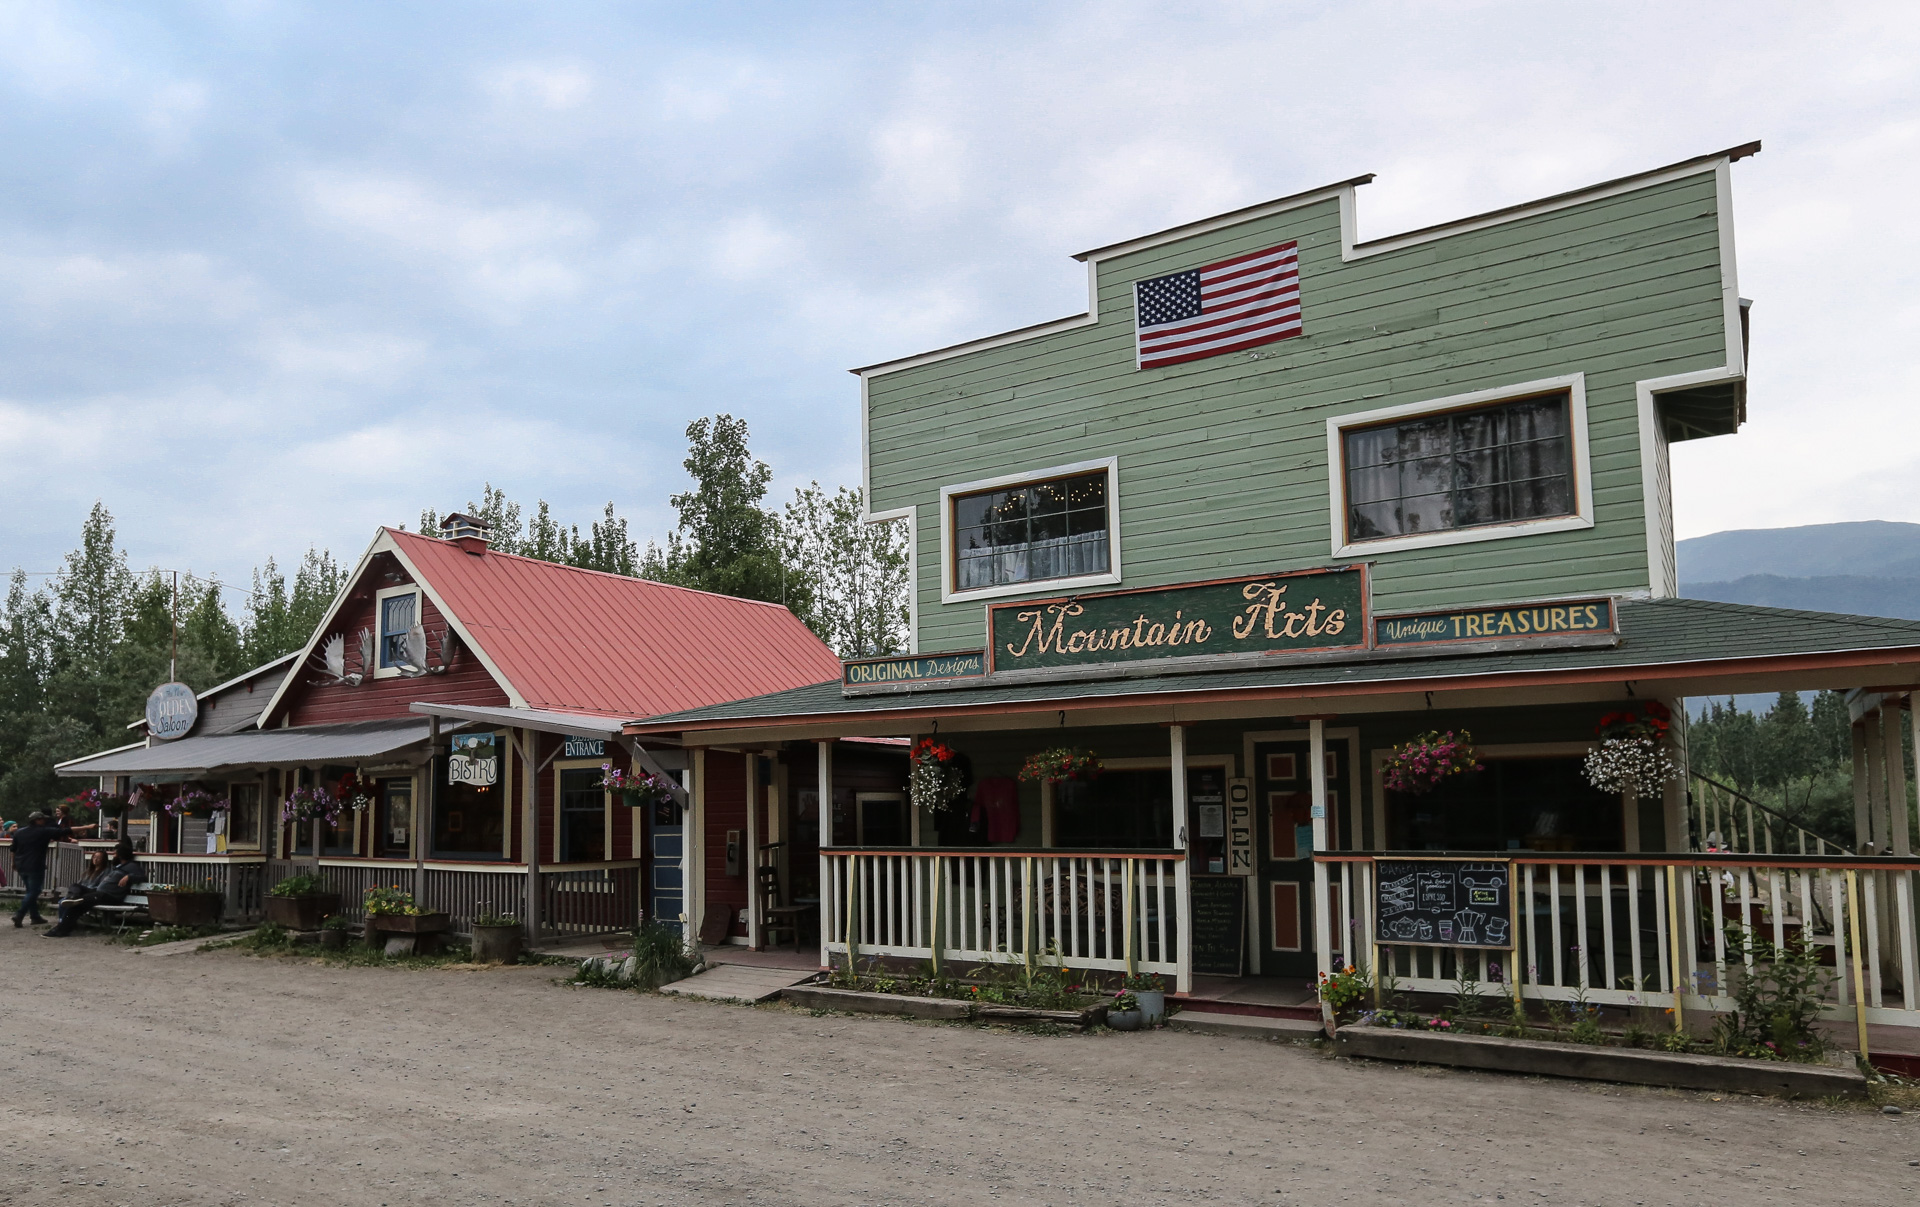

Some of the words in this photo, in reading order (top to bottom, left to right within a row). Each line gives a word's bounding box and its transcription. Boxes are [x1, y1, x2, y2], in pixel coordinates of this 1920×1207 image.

[1007, 602, 1213, 657] Mountain
[1232, 581, 1346, 640] Arts
[1386, 618, 1447, 639] Unique
[1450, 605, 1599, 637] TREASURES
[850, 660, 922, 683] ORIGINAL
[925, 656, 980, 676] Designs
[156, 716, 188, 734] Saloon
[565, 740, 605, 757] ENTRANCE
[448, 758, 498, 784] BISTRO
[1230, 784, 1251, 868] OPEN
